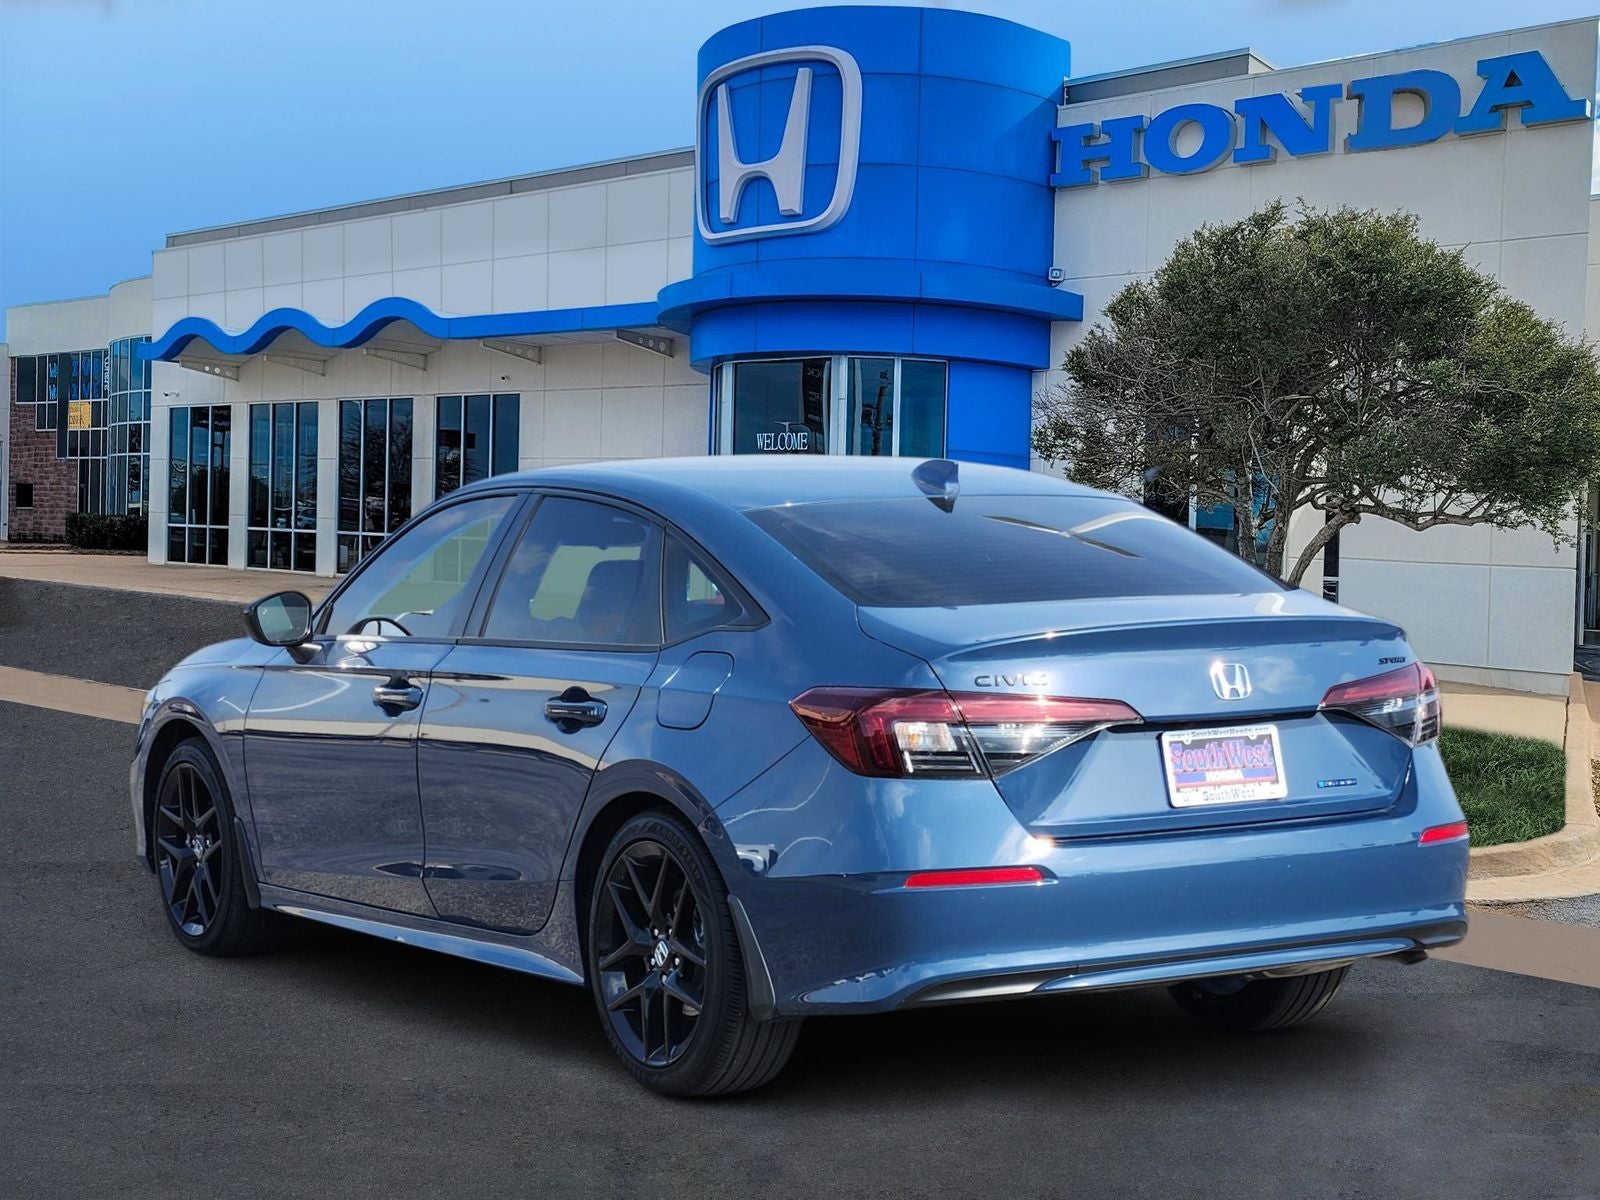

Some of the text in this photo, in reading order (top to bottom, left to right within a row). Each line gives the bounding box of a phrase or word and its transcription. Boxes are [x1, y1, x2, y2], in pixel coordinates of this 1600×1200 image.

[1050, 51, 1591, 188] HONDA
[756, 432, 808, 451] WELCOME
[1170, 738, 1274, 773] SouthWest
